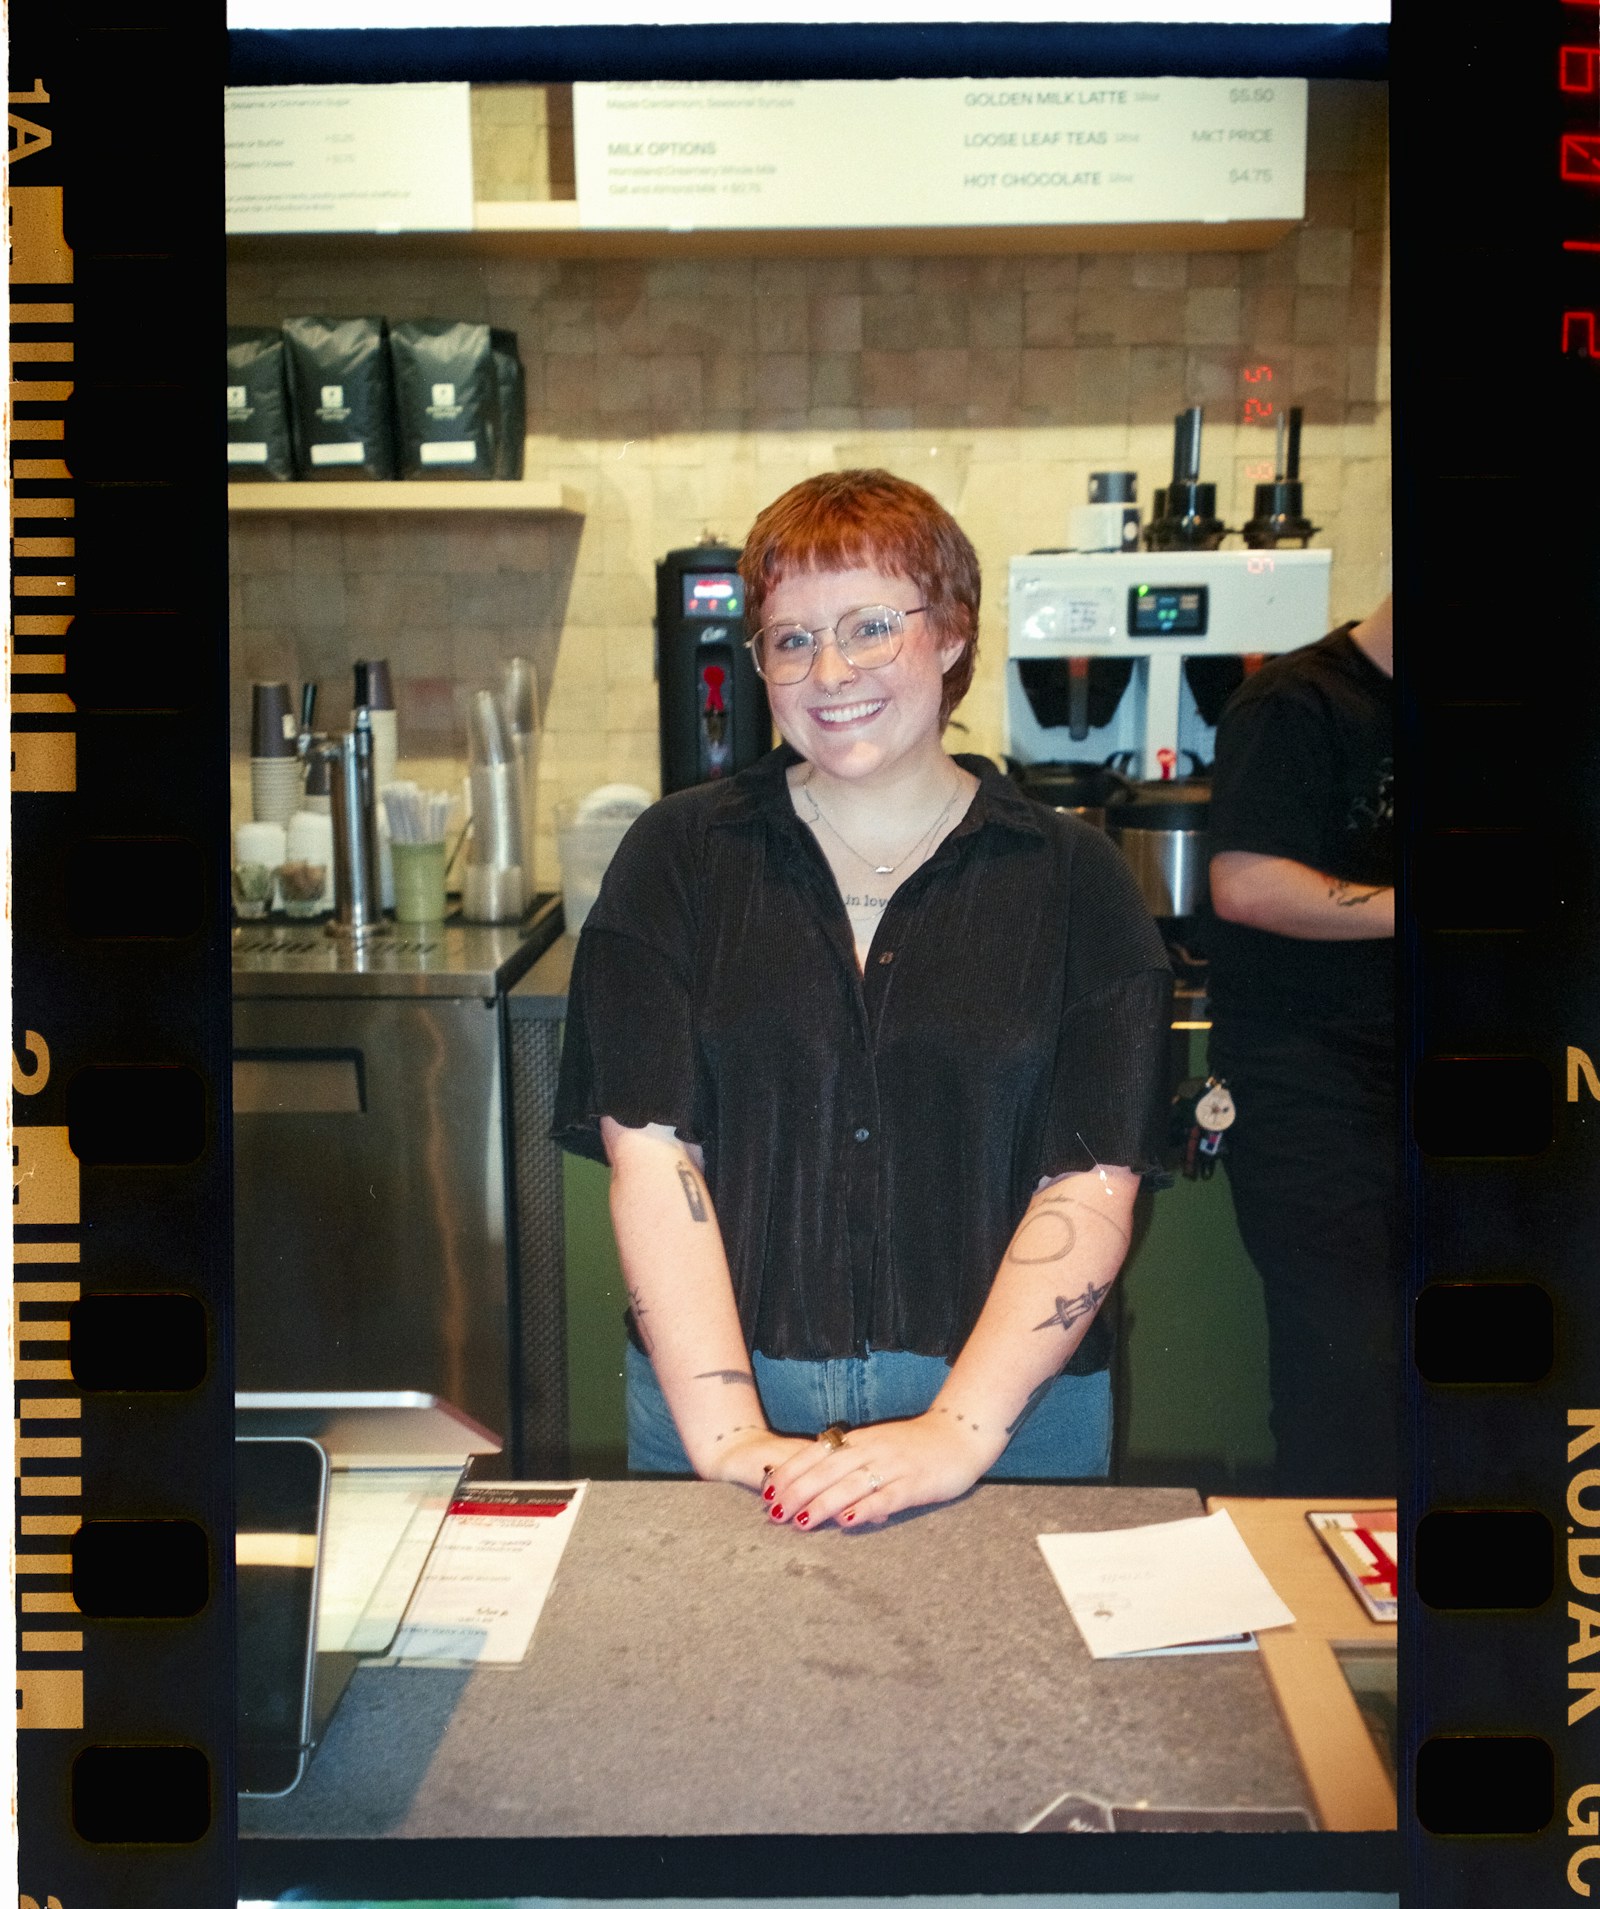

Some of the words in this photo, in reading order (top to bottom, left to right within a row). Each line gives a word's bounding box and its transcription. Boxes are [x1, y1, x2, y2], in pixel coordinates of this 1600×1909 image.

[963, 92, 1034, 107] GOLDEN
[1036, 91, 1075, 106] MILK
[1078, 90, 1128, 105] LATTE
[963, 132, 1018, 148] LOOSE
[1022, 131, 1062, 147] LEAF
[1066, 130, 1108, 146] TEAS
[1228, 128, 1273, 143] PRICE
[607, 141, 644, 156] MILK
[647, 140, 718, 156] OPTIONS
[963, 172, 997, 189] HOT
[1000, 170, 1101, 188] CHOCOLATE
[845, 894, 860, 906] in
